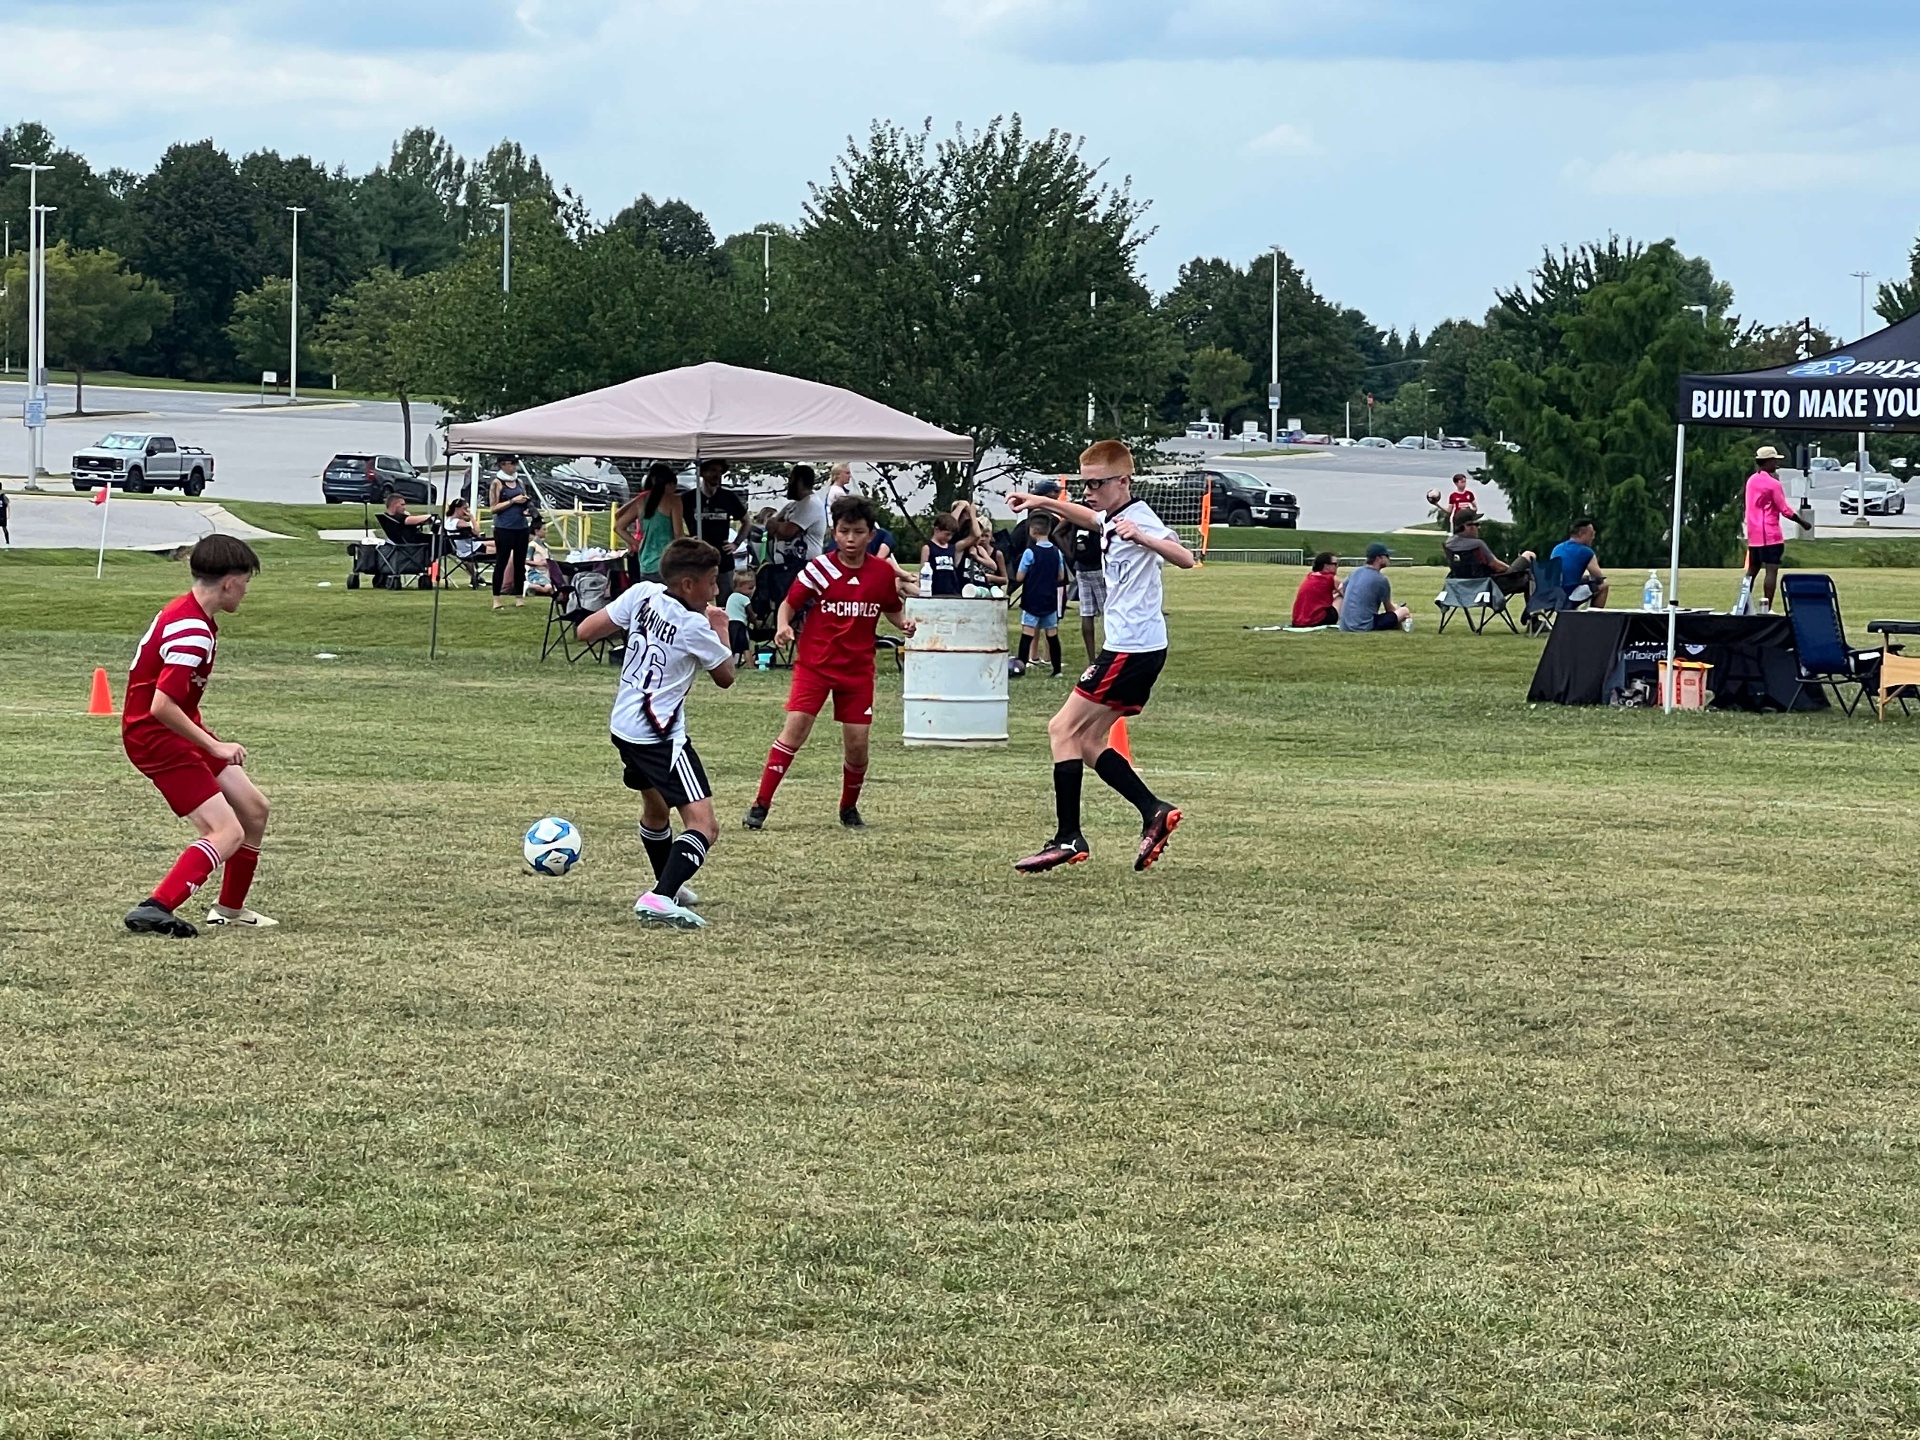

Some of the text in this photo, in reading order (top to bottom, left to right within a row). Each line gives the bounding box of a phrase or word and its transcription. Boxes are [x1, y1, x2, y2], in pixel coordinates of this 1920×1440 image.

[1691, 387, 1920, 418] BUILT TO MAKE YOU
[621, 631, 667, 693] 26
